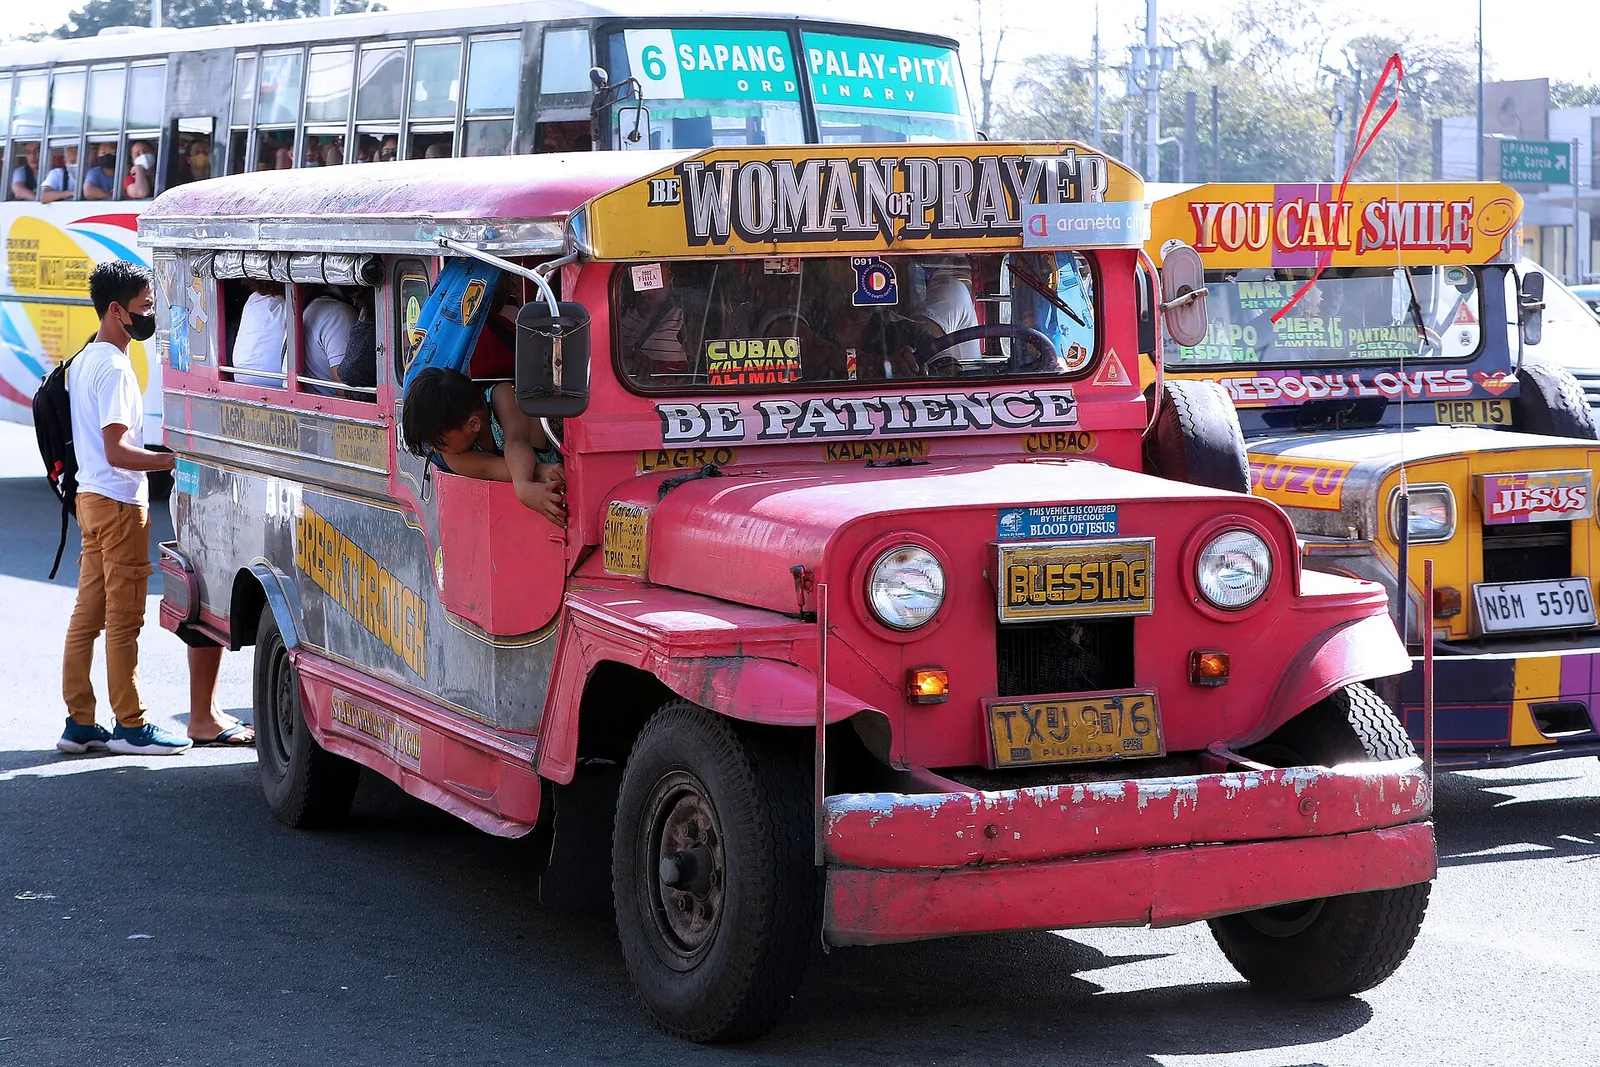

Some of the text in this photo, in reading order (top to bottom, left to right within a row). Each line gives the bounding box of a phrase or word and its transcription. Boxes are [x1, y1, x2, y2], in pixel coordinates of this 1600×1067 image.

[641, 44, 954, 87] 6 SAPANG PALAY-PITX
[1525, 157, 1552, 168] Garcia
[1502, 169, 1542, 181] Eastwood
[649, 150, 1108, 241] BE WOMAN OF PRAYER
[1056, 213, 1120, 231] araneta
[1190, 197, 1474, 253] YOU CAN SMILE
[1238, 280, 1297, 299] MRT
[1241, 299, 1297, 308] HI-WA
[1200, 324, 1257, 347] IAPO
[1272, 317, 1342, 348] PIER 15
[1274, 339, 1328, 348] LAWTON
[1278, 332, 1323, 340] SOUTH
[707, 338, 799, 361] CUBAO
[1180, 346, 1260, 361] ESPAÑA
[1349, 349, 1418, 359] FISHER MALL
[1356, 341, 1409, 350] DELTA
[708, 358, 799, 374] KALAYAAN
[1351, 369, 1472, 397] LOVES
[657, 389, 1078, 441] BE PATIENCE
[1437, 400, 1504, 424] PIER 15
[826, 440, 923, 461] KALAYAAN
[1026, 431, 1091, 453] CUBAO
[642, 447, 733, 471] LAGRO
[1250, 462, 1344, 495] SUZU
[1029, 505, 1116, 516] THIS VEHICLE IS COVERED
[1491, 486, 1587, 517] JESUS
[1030, 521, 1116, 536] BLOOD OF JESUS
[1041, 513, 1104, 523] BY THE PRECIOUS
[296, 503, 426, 681] BREAKTHROUGH
[1008, 560, 1146, 606] BLESSING
[1484, 589, 1590, 620] NBM 5590
[405, 729, 420, 760] GOD
